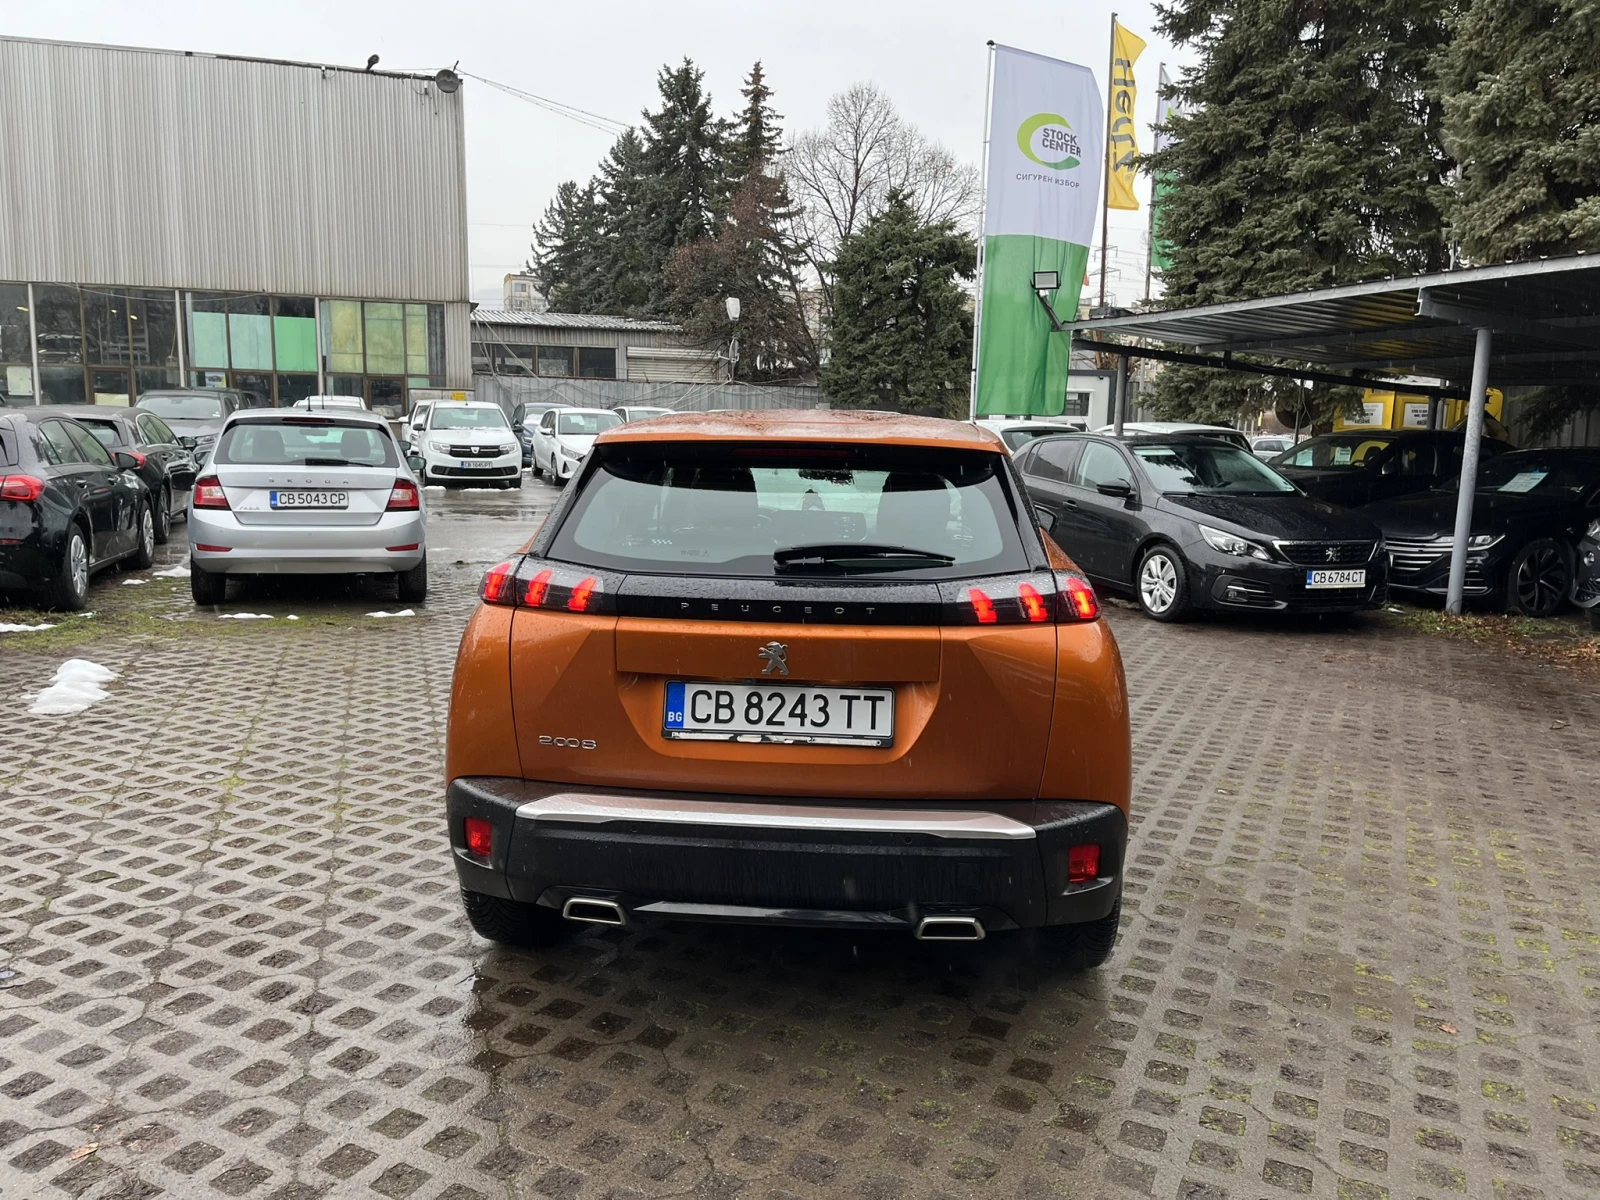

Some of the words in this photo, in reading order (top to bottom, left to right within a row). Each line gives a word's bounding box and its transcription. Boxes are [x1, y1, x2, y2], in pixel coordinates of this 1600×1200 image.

[1043, 128, 1077, 145] STOCK
[1042, 138, 1081, 158] CENTER
[1016, 173, 1053, 183] СИГУРЕН
[1054, 178, 1080, 188] ИЗБОР
[279, 493, 295, 505] CB
[297, 493, 328, 505] 5043
[329, 493, 346, 505] CP
[1313, 572, 1326, 583] CB
[1328, 572, 1351, 583] 6784
[1352, 572, 1364, 582] CT
[681, 602, 876, 615] PEUGEOT
[667, 711, 683, 723] BG
[690, 689, 736, 725] CB
[743, 690, 831, 728] 8243
[839, 694, 886, 731] TT
[538, 735, 597, 750] 2008
